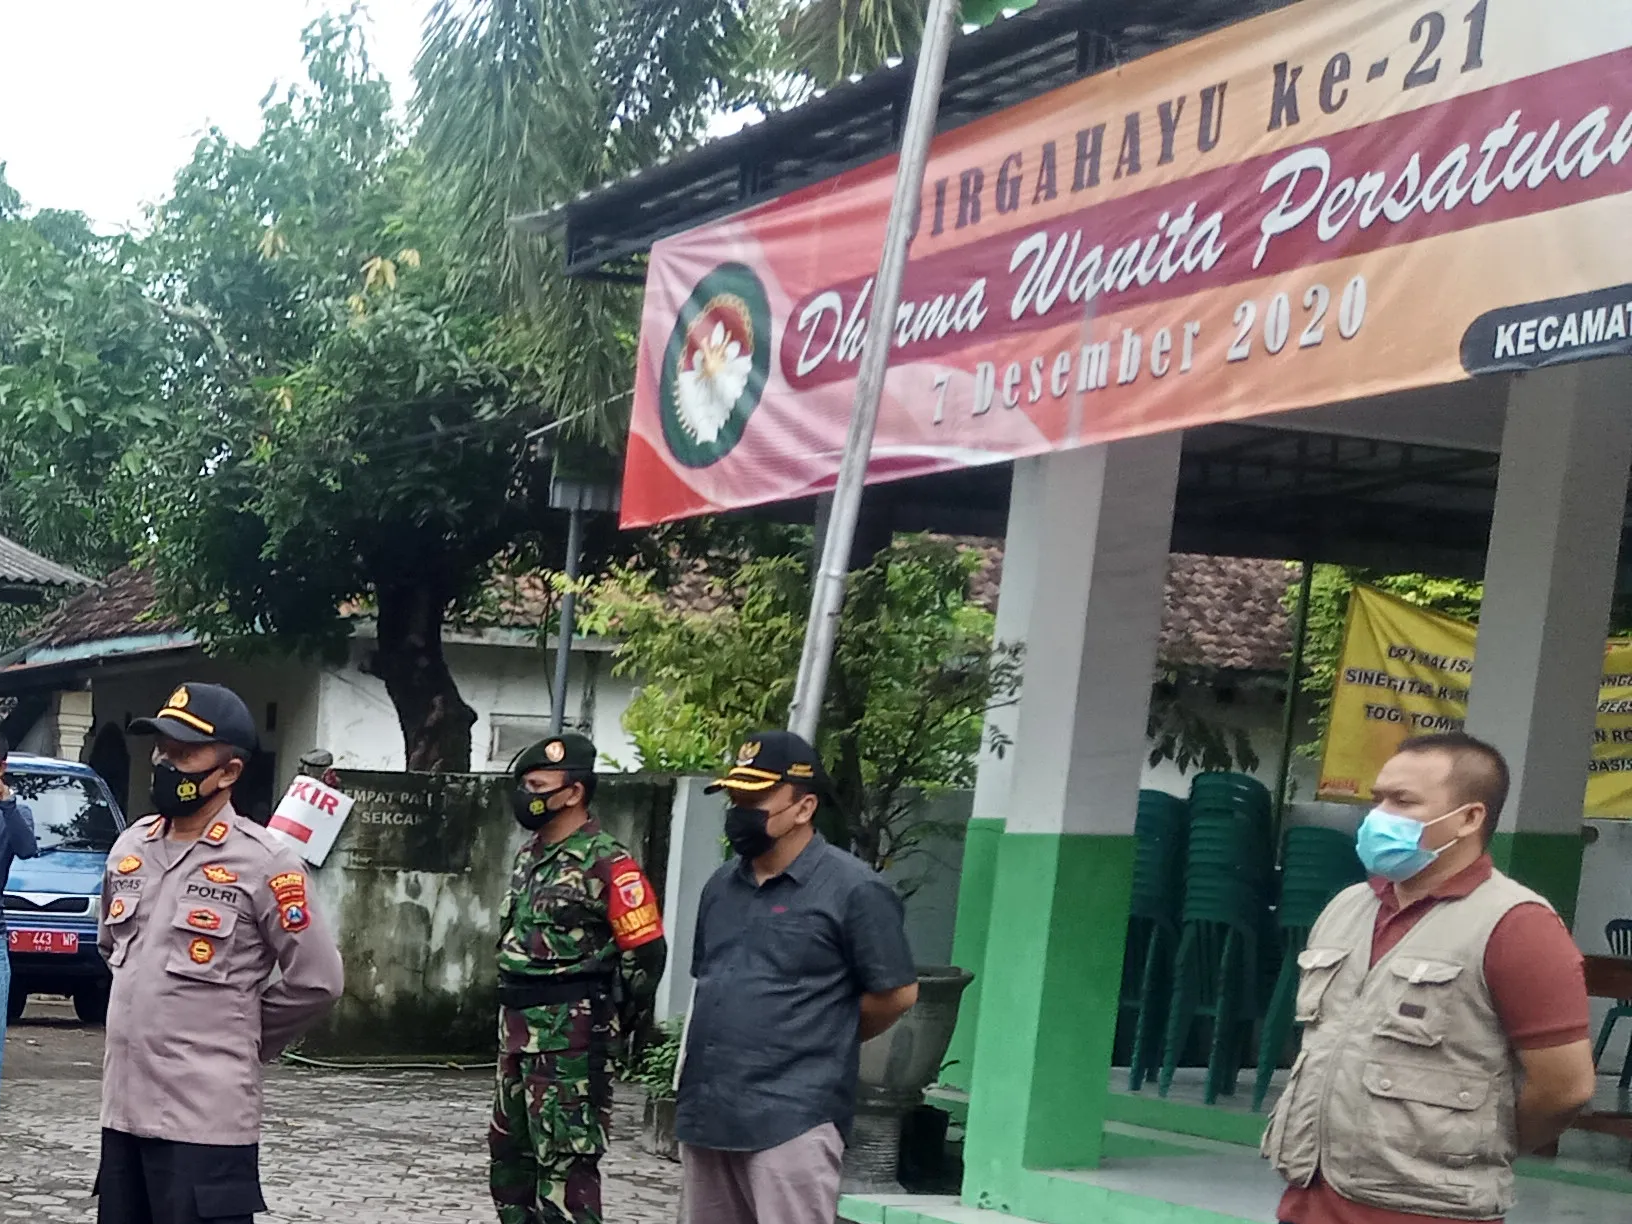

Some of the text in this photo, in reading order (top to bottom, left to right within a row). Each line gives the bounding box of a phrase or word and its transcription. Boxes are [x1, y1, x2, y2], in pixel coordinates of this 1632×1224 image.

[909, 0, 1489, 242] IRGAHAYU ke-21
[796, 277, 989, 377] Dhrma
[1009, 201, 1227, 321] Wanita
[932, 274, 1367, 425] 7 Desember 2020
[342, 789, 394, 804] EMPAT
[361, 812, 422, 825] SEKCA
[186, 884, 238, 904] POLRI
[11, 931, 77, 946] S 443 WP
